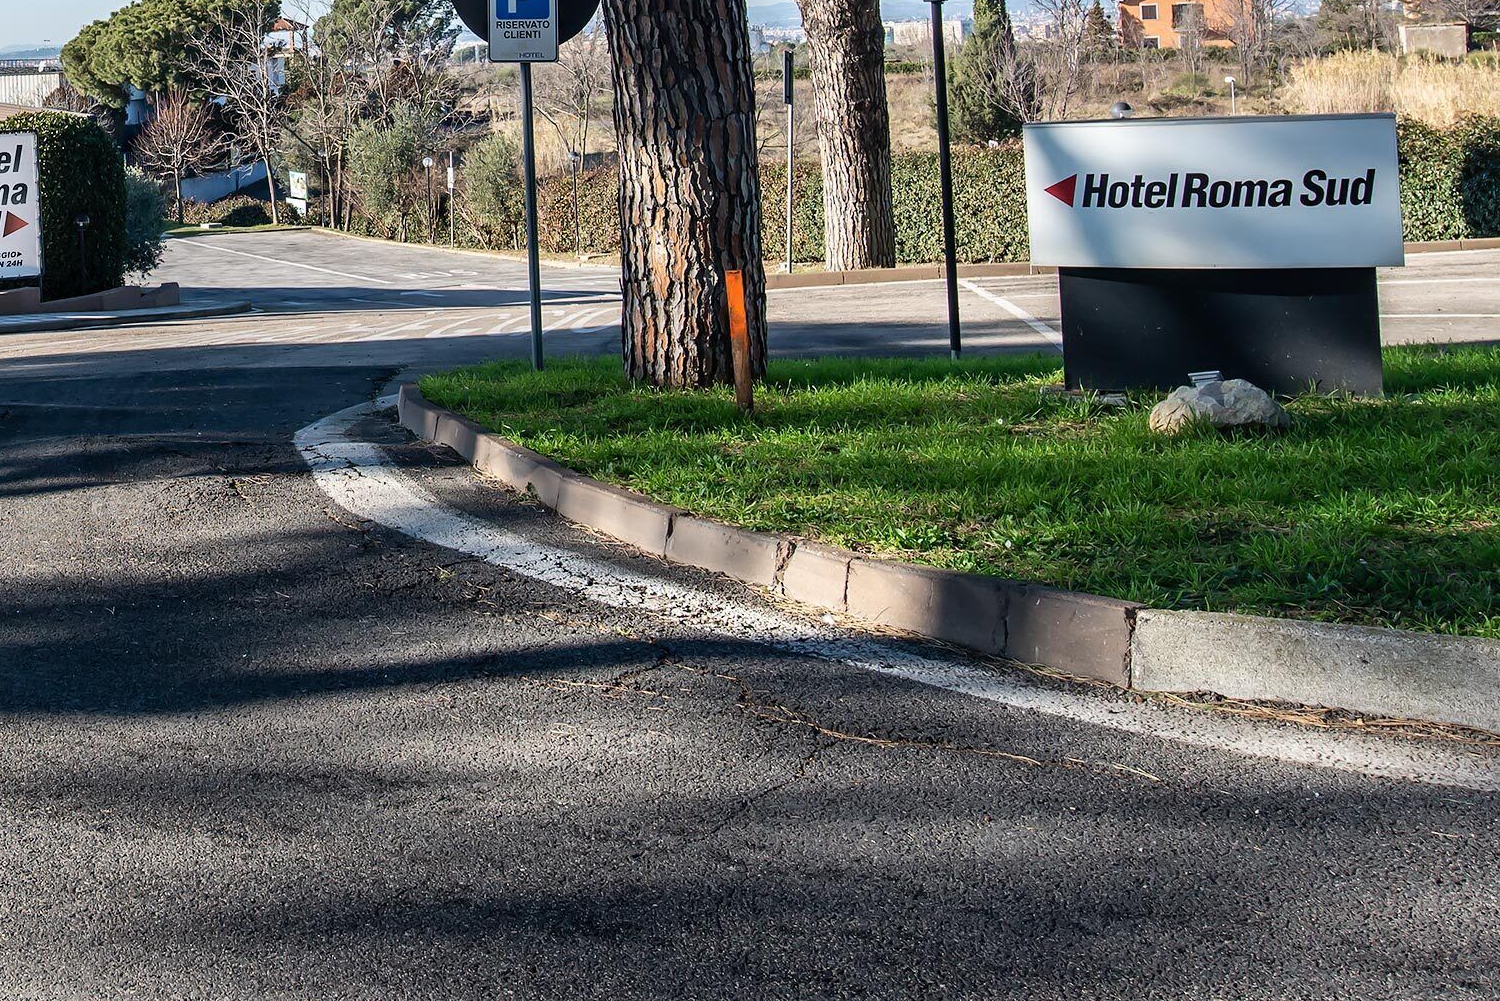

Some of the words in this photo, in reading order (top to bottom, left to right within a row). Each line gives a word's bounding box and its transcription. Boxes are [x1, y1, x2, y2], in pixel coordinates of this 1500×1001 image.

[496, 20, 550, 29] RISERVATO
[503, 30, 541, 39] CLIENTI
[1082, 173, 1178, 208] Hotel
[1181, 172, 1293, 207] Roma
[1300, 168, 1376, 207] Sud
[6, 260, 23, 268] 24H
